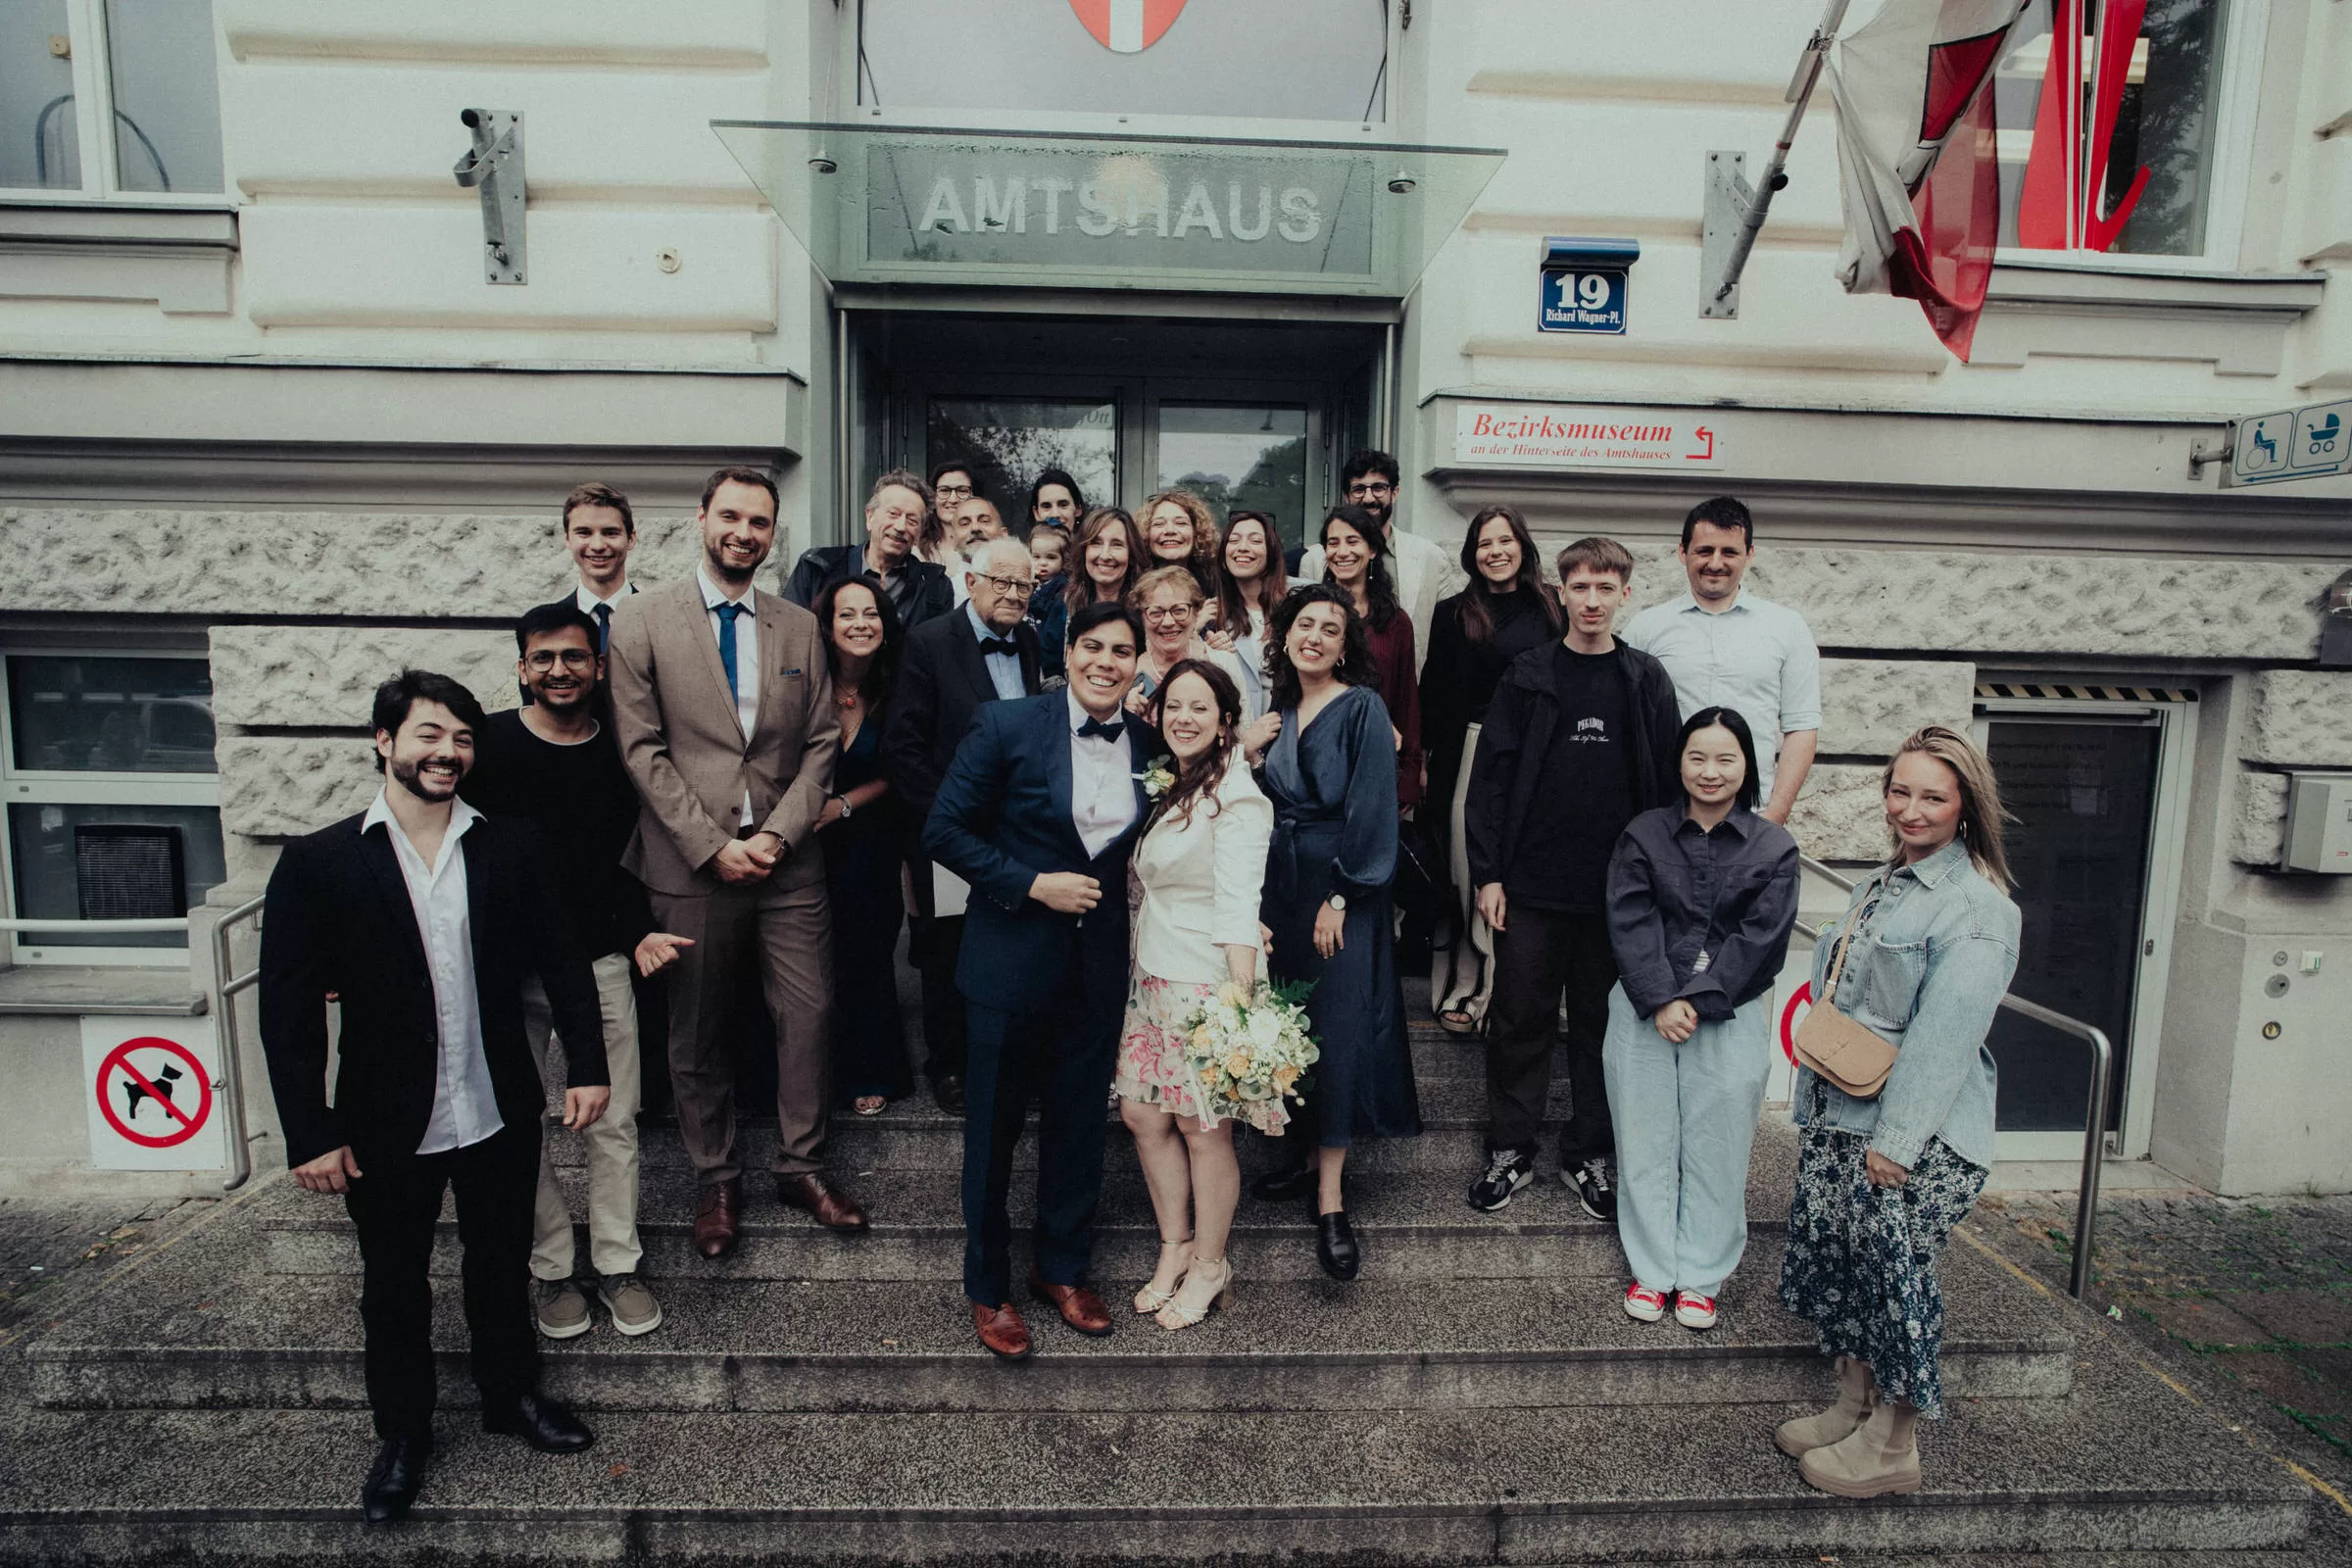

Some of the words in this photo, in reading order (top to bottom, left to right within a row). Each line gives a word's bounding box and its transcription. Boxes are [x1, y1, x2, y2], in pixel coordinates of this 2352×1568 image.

[917, 174, 1321, 242] AMTSHAUS
[1555, 273, 1610, 310] 19
[1545, 308, 1576, 322] Richard
[1473, 414, 1672, 442] Bezirksmuseum
[1470, 445, 1486, 455] an
[1489, 444, 1509, 455] der
[1512, 444, 1577, 457] Hinterseite
[1580, 446, 1598, 458] des
[1604, 447, 1671, 460] Amtshauses
